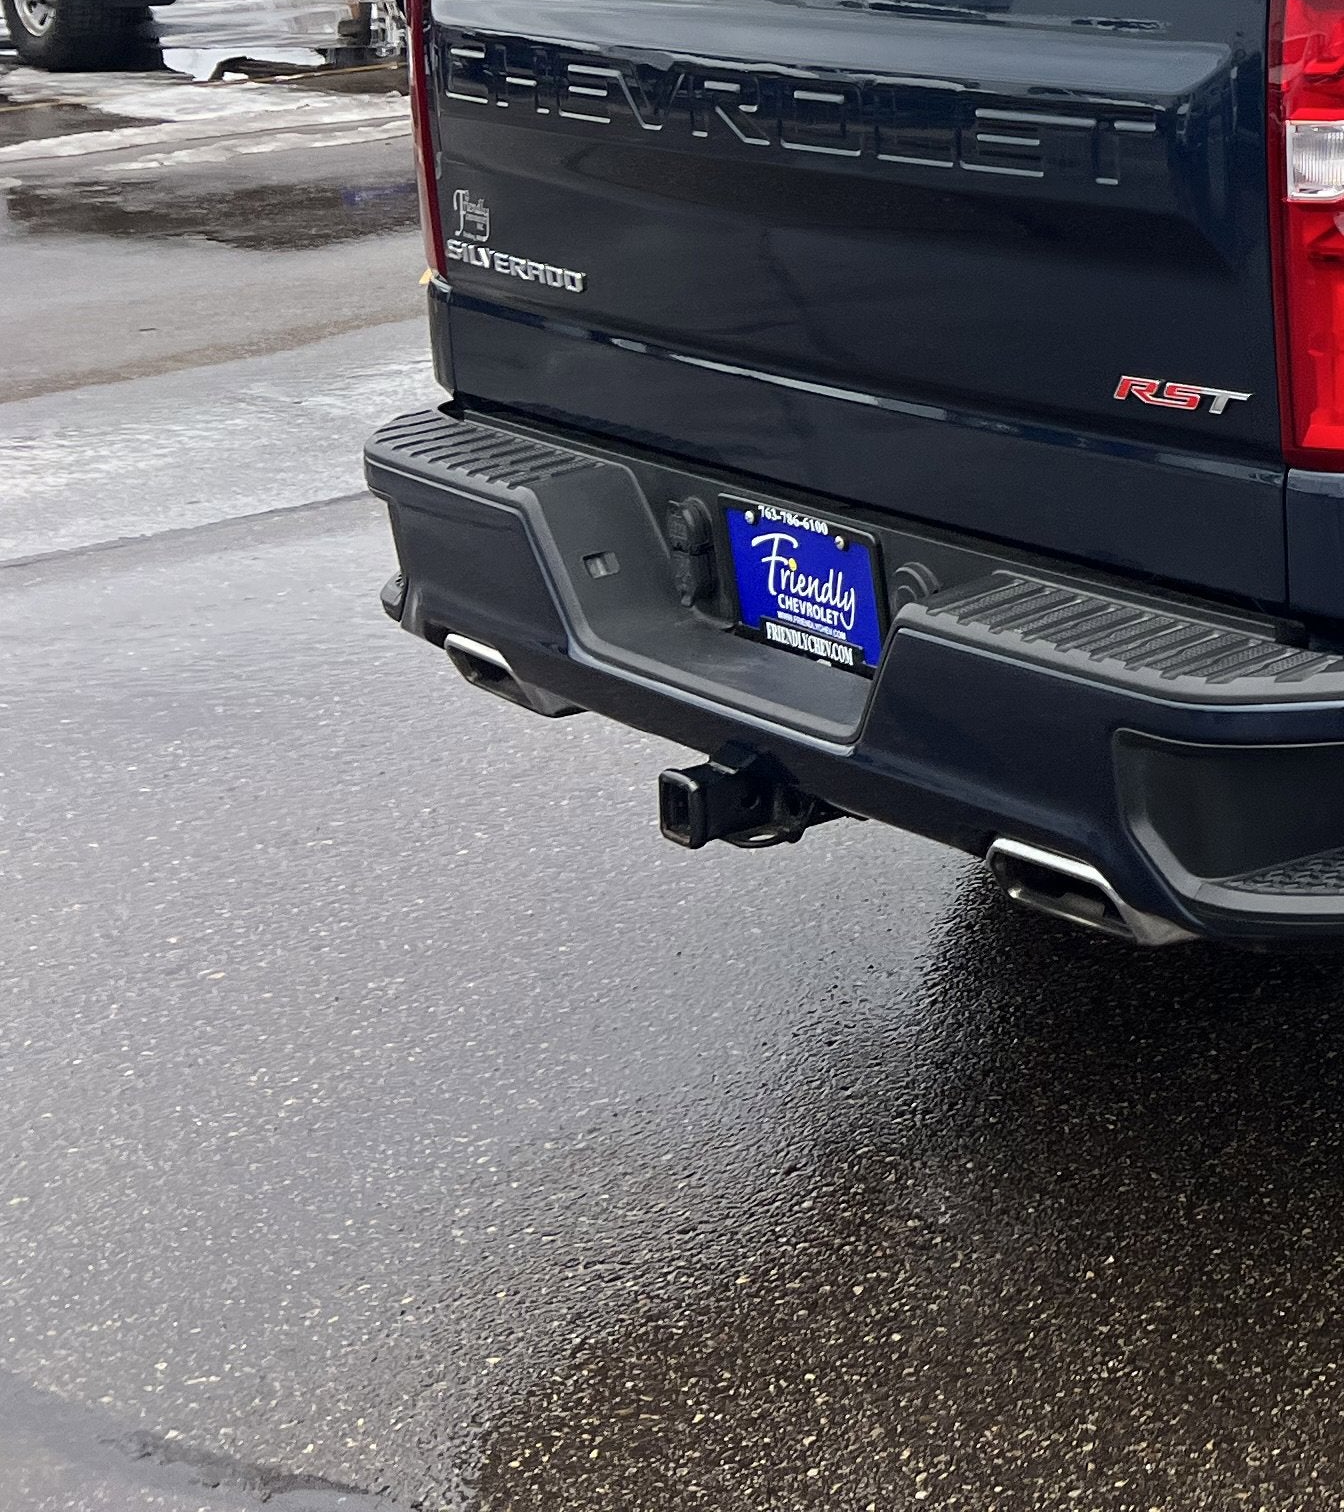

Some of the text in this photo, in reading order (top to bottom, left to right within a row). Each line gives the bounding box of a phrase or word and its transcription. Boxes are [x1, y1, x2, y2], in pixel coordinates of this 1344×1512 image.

[444, 45, 1158, 185] CHEVROLET
[446, 239, 586, 293] SILVERADO
[1113, 375, 1255, 415] RST
[758, 505, 829, 536] 763-786-6100
[751, 532, 857, 630] Friendly
[777, 593, 840, 626] CHEVROLET
[765, 621, 854, 666] FRIENDLYCHEV.COM
